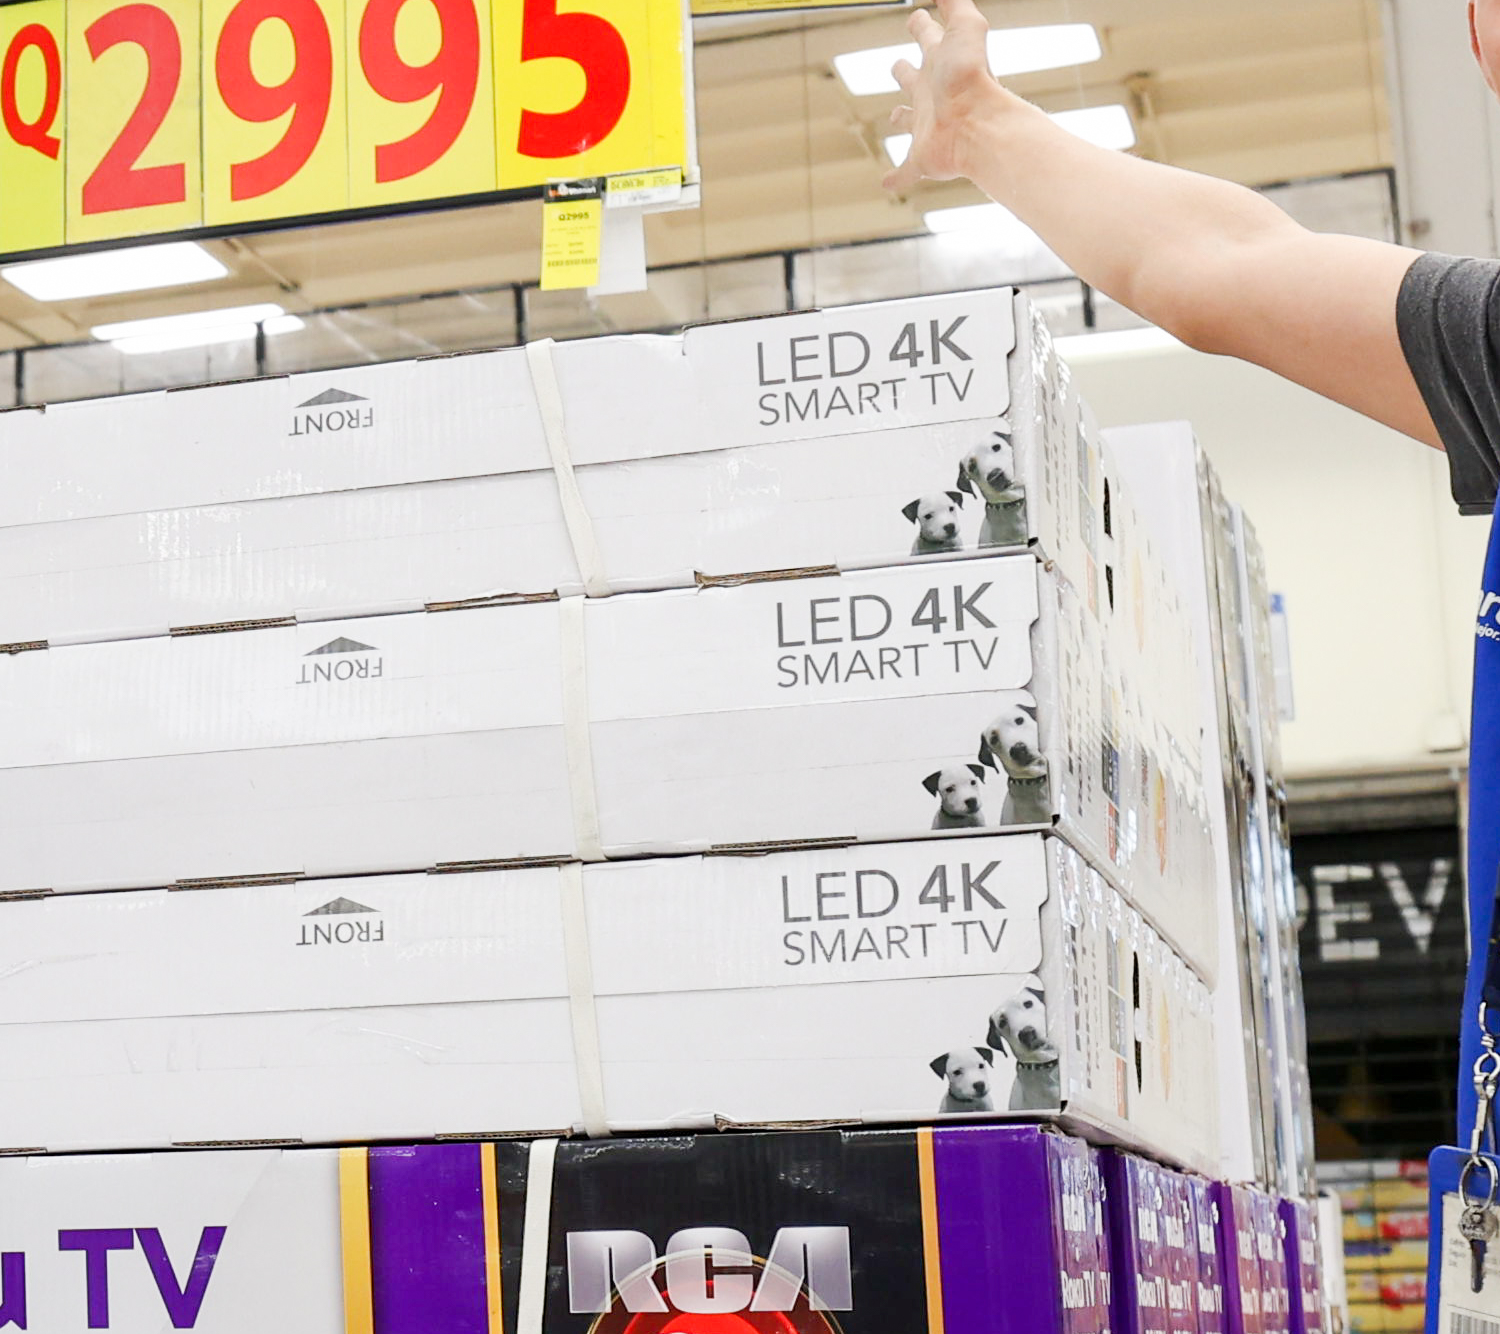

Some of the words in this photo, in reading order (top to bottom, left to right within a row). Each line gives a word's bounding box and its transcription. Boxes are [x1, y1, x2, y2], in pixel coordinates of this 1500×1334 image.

[757, 325, 870, 388] LED
[888, 314, 974, 372] 4K
[289, 407, 374, 436] FRONT
[758, 379, 906, 428] SMART
[917, 368, 976, 407] TV
[775, 592, 893, 649] LED
[911, 581, 998, 634] 4K
[296, 656, 383, 686] FRONT
[776, 646, 928, 690] SMART
[941, 637, 1000, 675] TV
[782, 866, 900, 924] LED
[918, 858, 1007, 913] 4K
[295, 918, 386, 946] FRONT
[783, 926, 936, 967] SMART
[949, 917, 1010, 955] TV
[56, 1225, 228, 1331] TV
[566, 1226, 853, 1315] RCA
